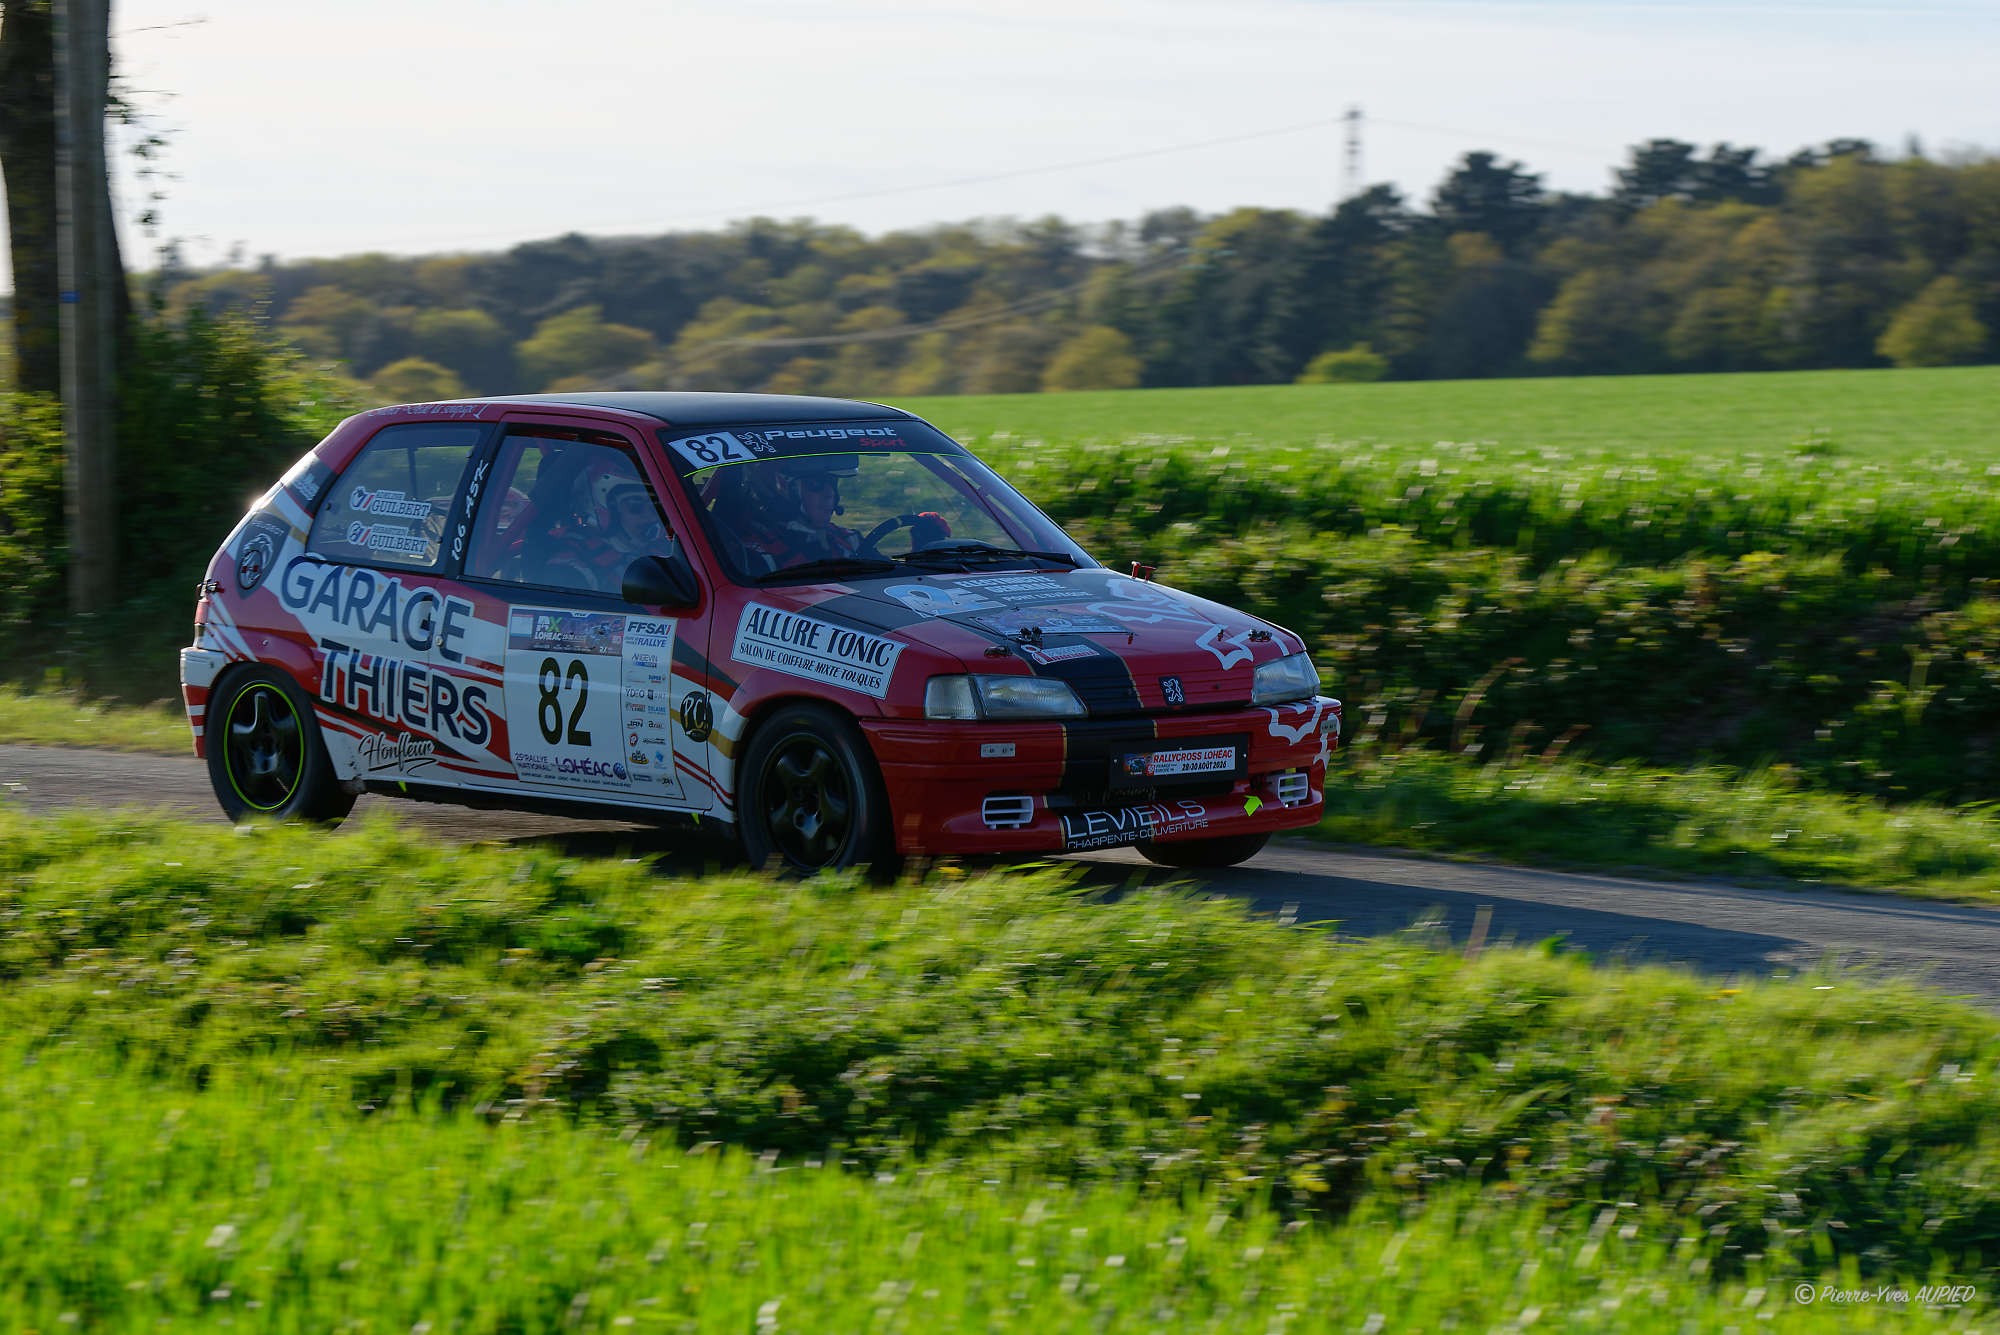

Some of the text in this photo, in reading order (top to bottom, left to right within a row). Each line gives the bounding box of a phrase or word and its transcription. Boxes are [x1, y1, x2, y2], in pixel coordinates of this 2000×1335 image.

[685, 427, 897, 462] 82 Peugeot
[858, 437, 906, 448] Sport
[372, 499, 430, 516] GUILBERT
[369, 534, 427, 552] GUILBERT
[281, 555, 472, 663] GARAGE
[627, 622, 666, 635] FFSA
[637, 638, 667, 647] RALLYE
[745, 607, 895, 667] ALLURE TONIC
[739, 642, 882, 690] SALON DE COIFFURE MIXTE TOUQUES
[320, 638, 490, 745] THIERS
[538, 656, 592, 747] 82
[358, 733, 434, 772] Honfleur
[555, 757, 614, 778] LOHÉAC
[1153, 749, 1233, 763] RALLYCROSS LOHÉAC
[1063, 799, 1206, 839] LEVIEILS
